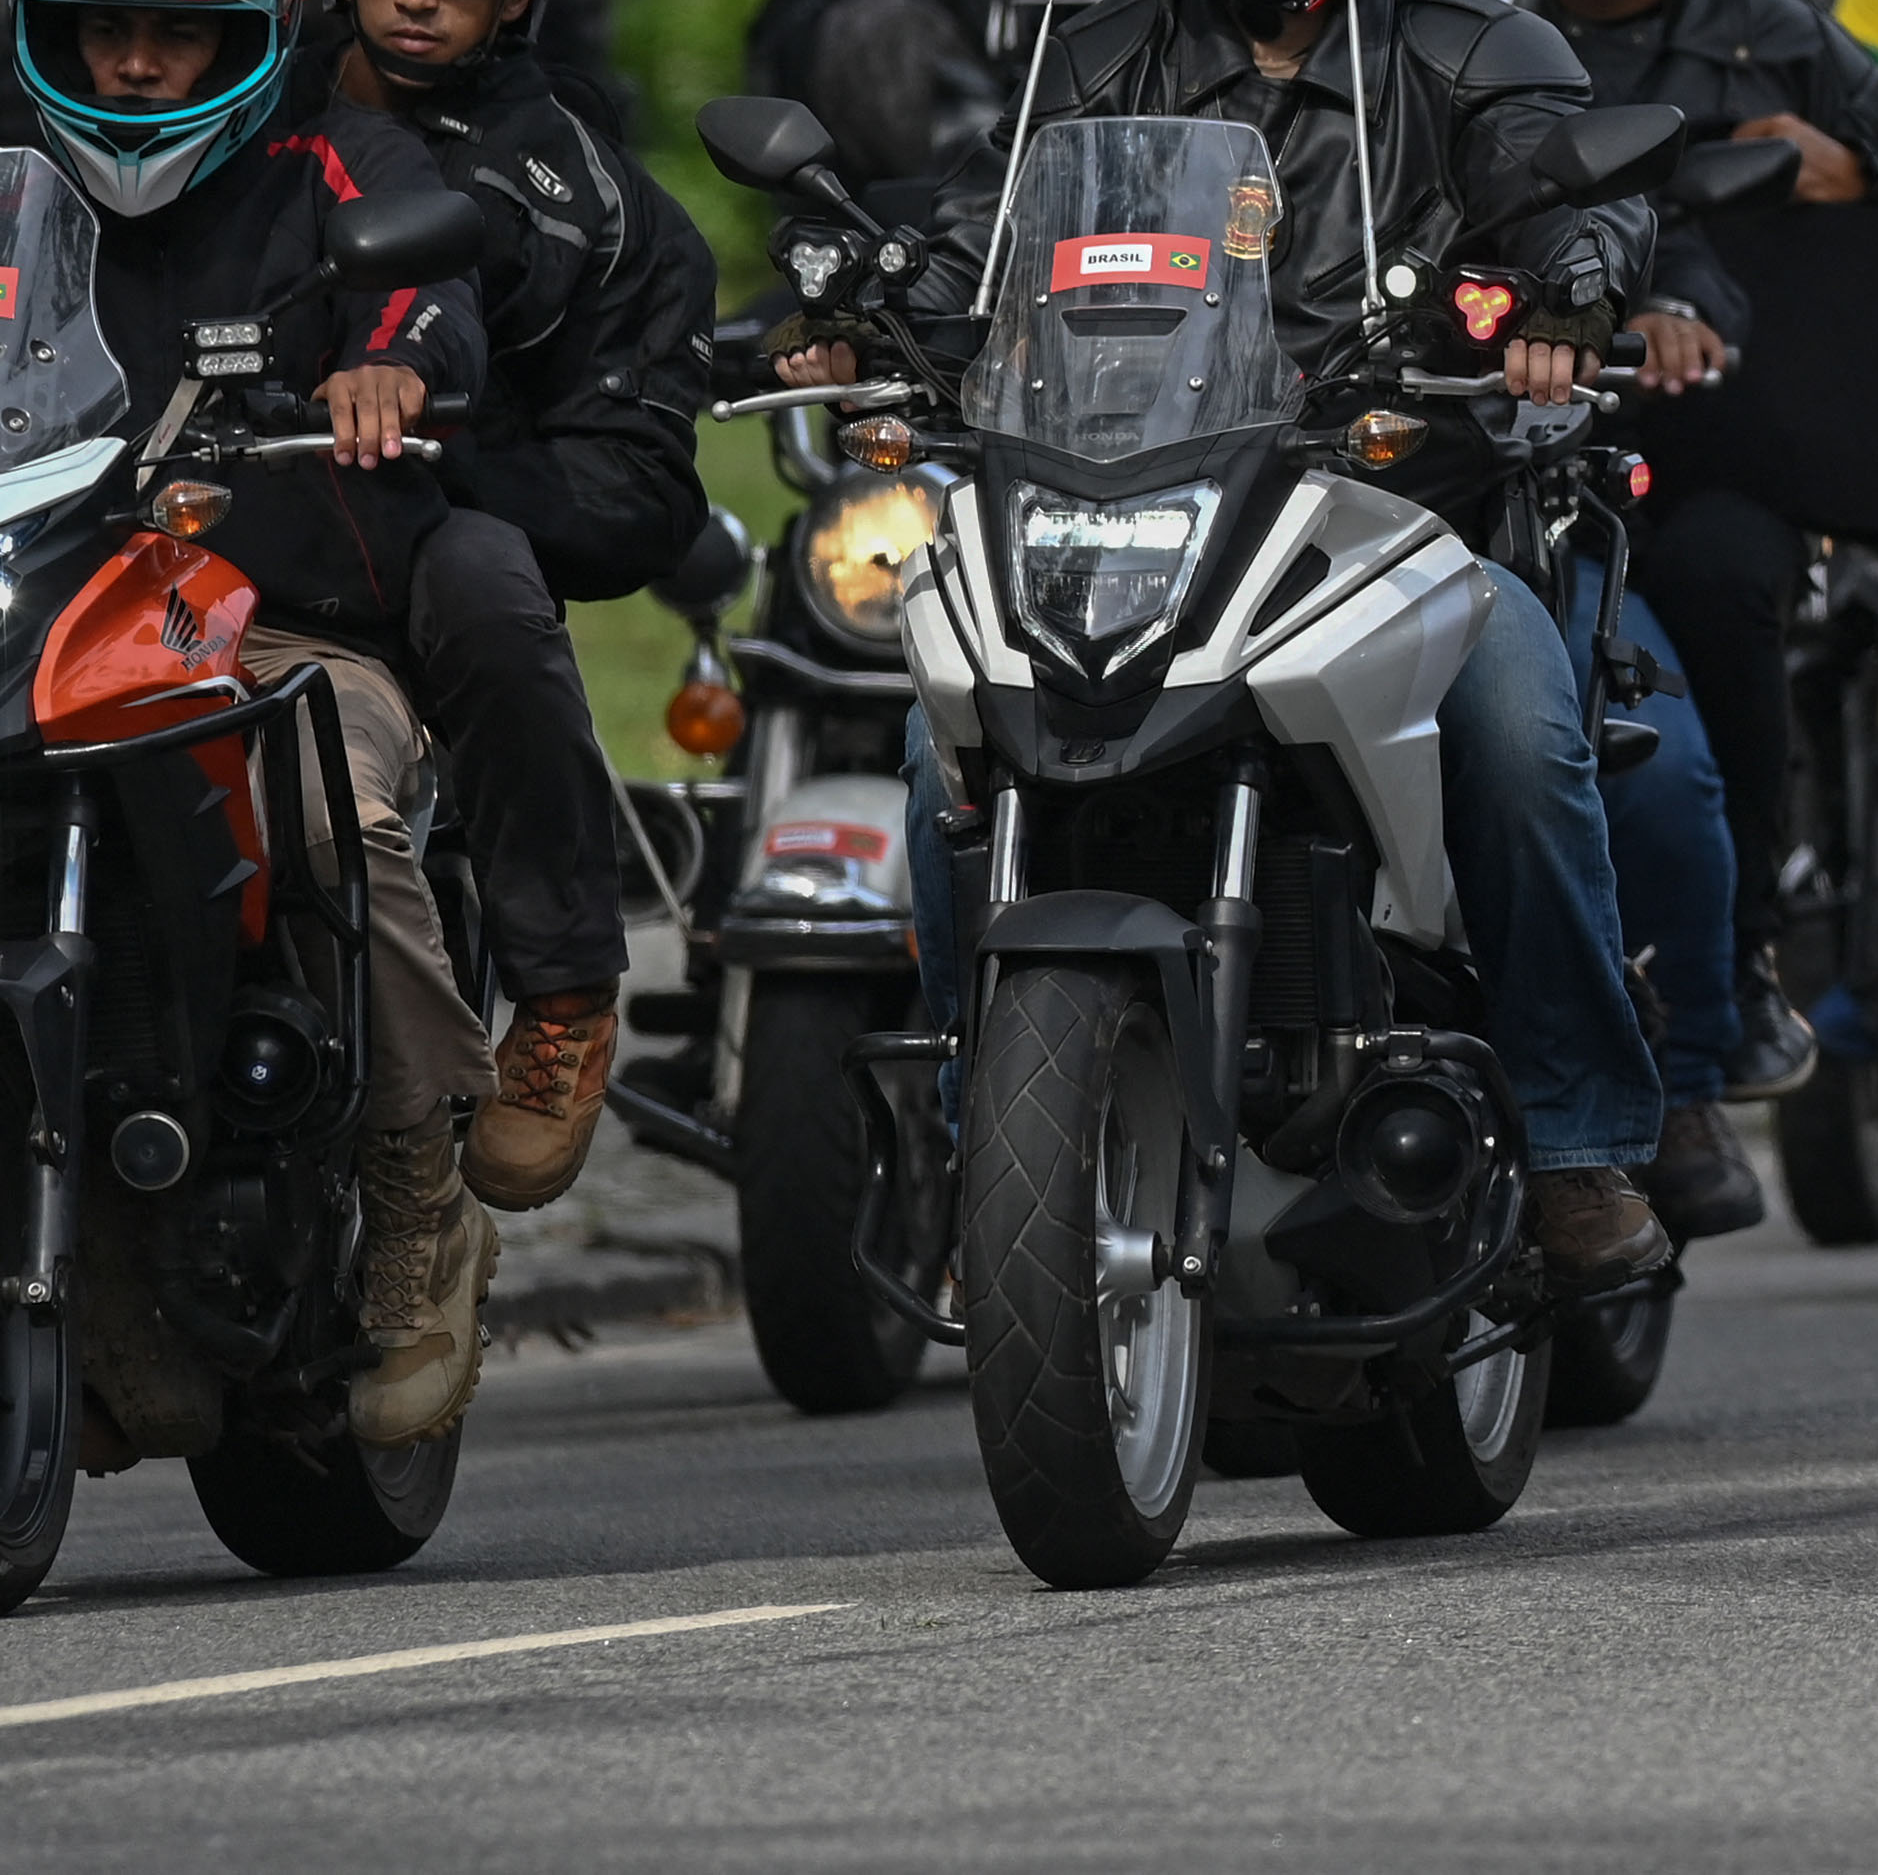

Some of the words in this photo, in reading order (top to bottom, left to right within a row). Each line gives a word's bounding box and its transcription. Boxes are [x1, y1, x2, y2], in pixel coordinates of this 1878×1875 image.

[525, 156, 566, 196] HELT
[1087, 252, 1144, 265] BRASIL
[180, 634, 229, 672] HONDA
